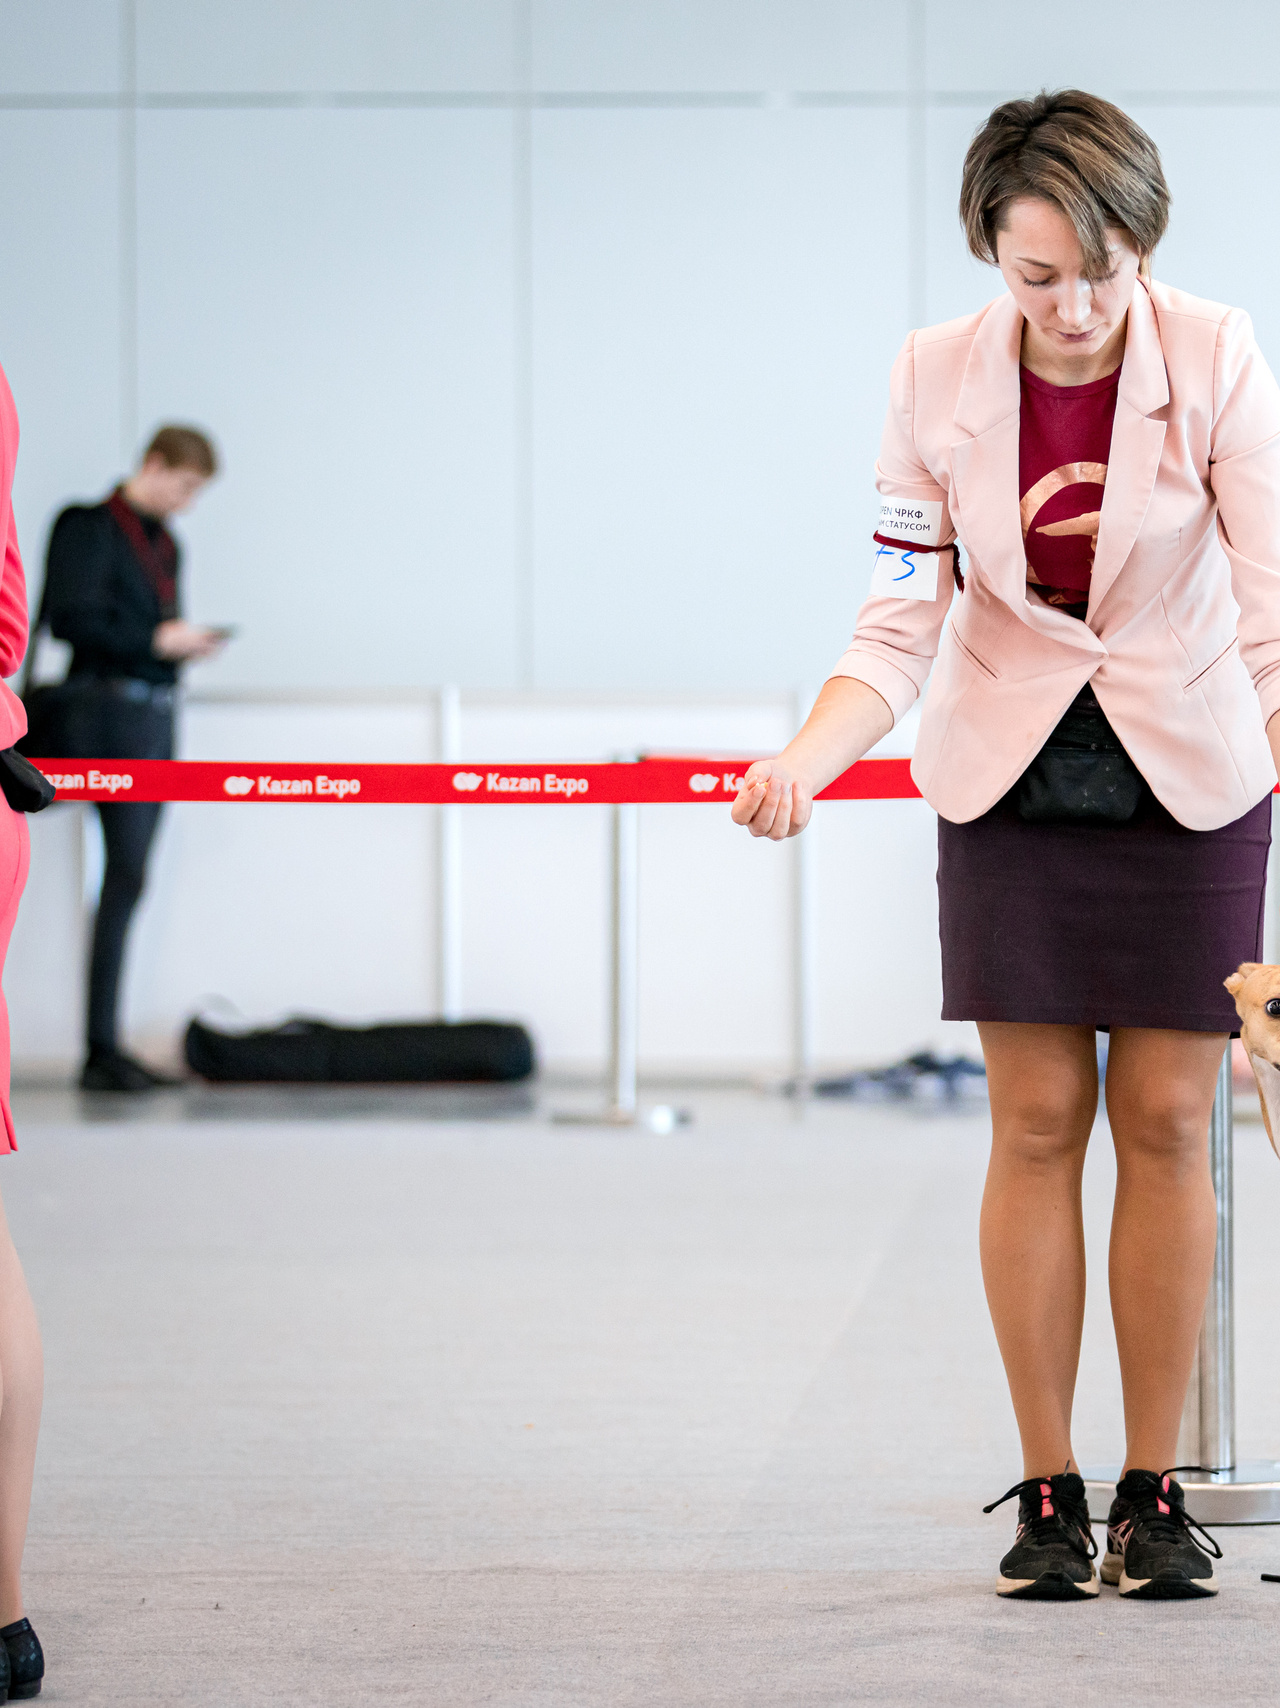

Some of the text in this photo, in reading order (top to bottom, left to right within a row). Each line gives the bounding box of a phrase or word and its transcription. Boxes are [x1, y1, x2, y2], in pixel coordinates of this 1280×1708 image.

[894, 508, 923, 519] ЧРКФ
[885, 520, 931, 531] СТАТУСОМ
[40, 771, 133, 793] azan Expo
[258, 776, 360, 796] Kazan Expo
[487, 773, 588, 796] Kazan Expo
